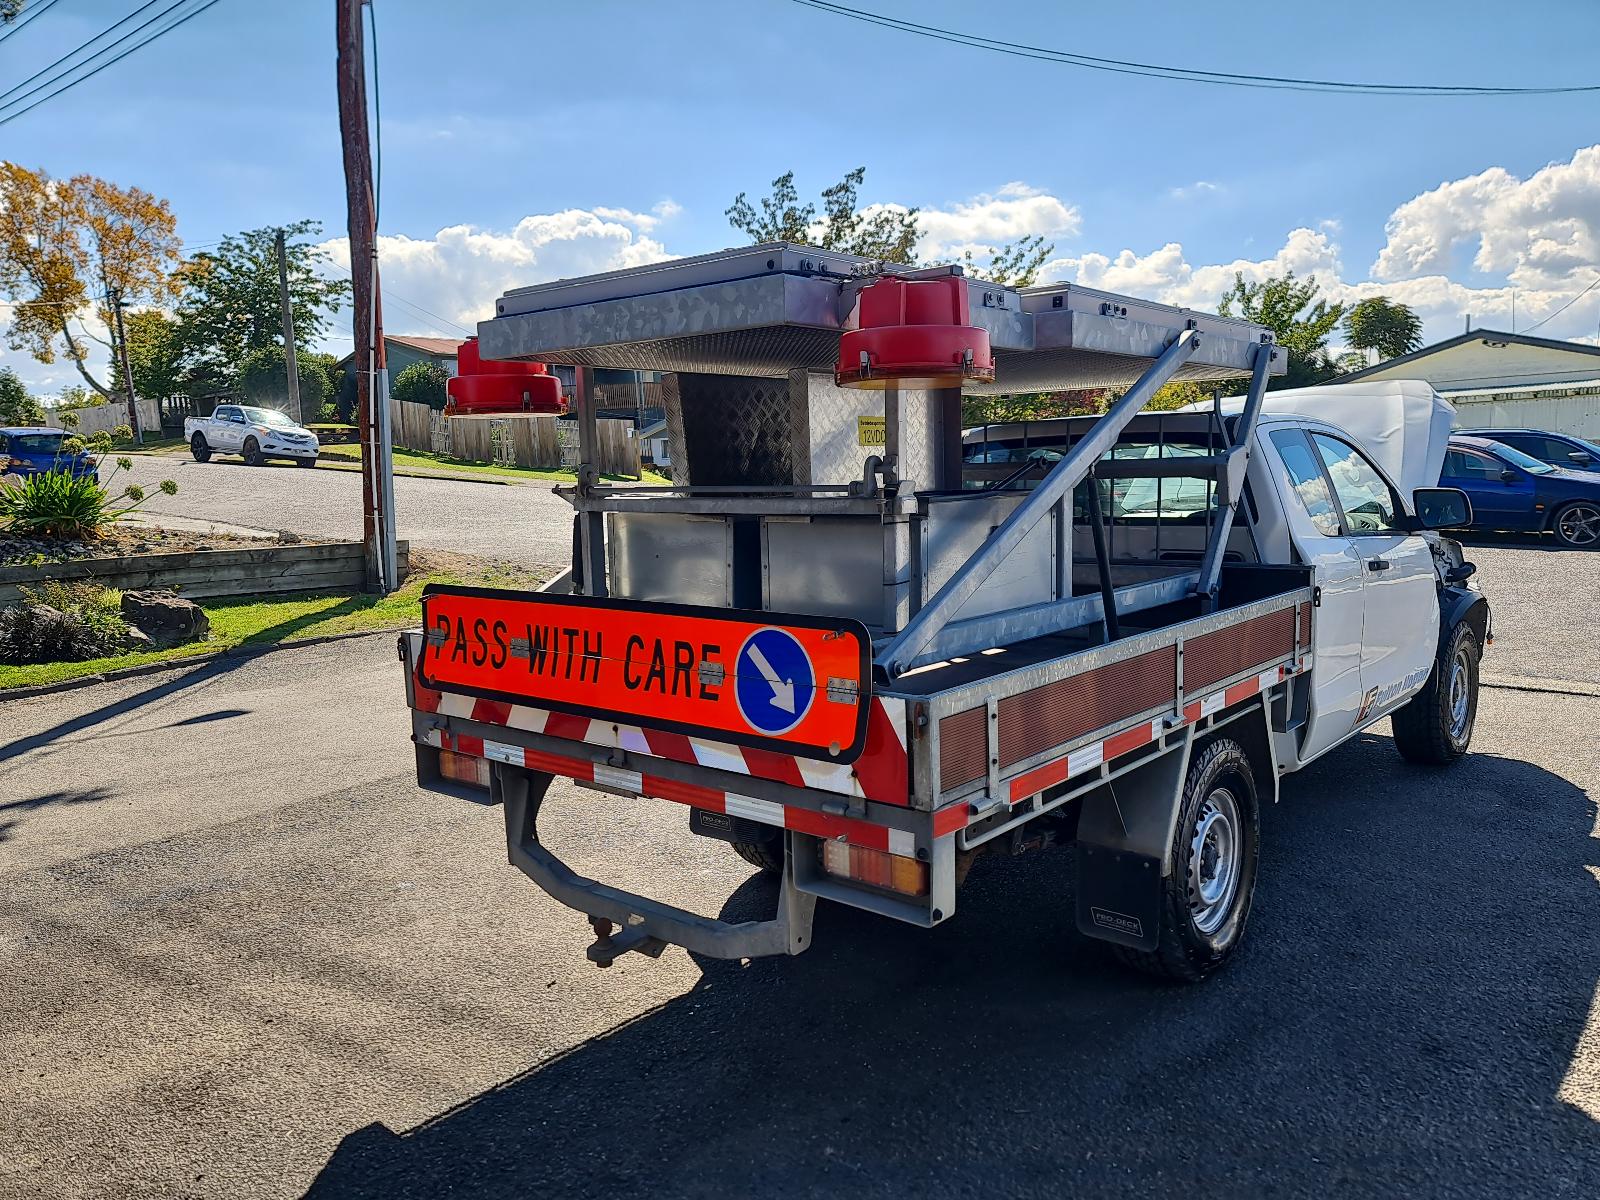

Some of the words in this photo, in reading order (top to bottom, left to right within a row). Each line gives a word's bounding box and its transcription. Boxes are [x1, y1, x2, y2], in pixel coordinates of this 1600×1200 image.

[434, 614, 508, 669] PASS
[526, 624, 602, 683] WITH
[623, 634, 721, 702] CARE
